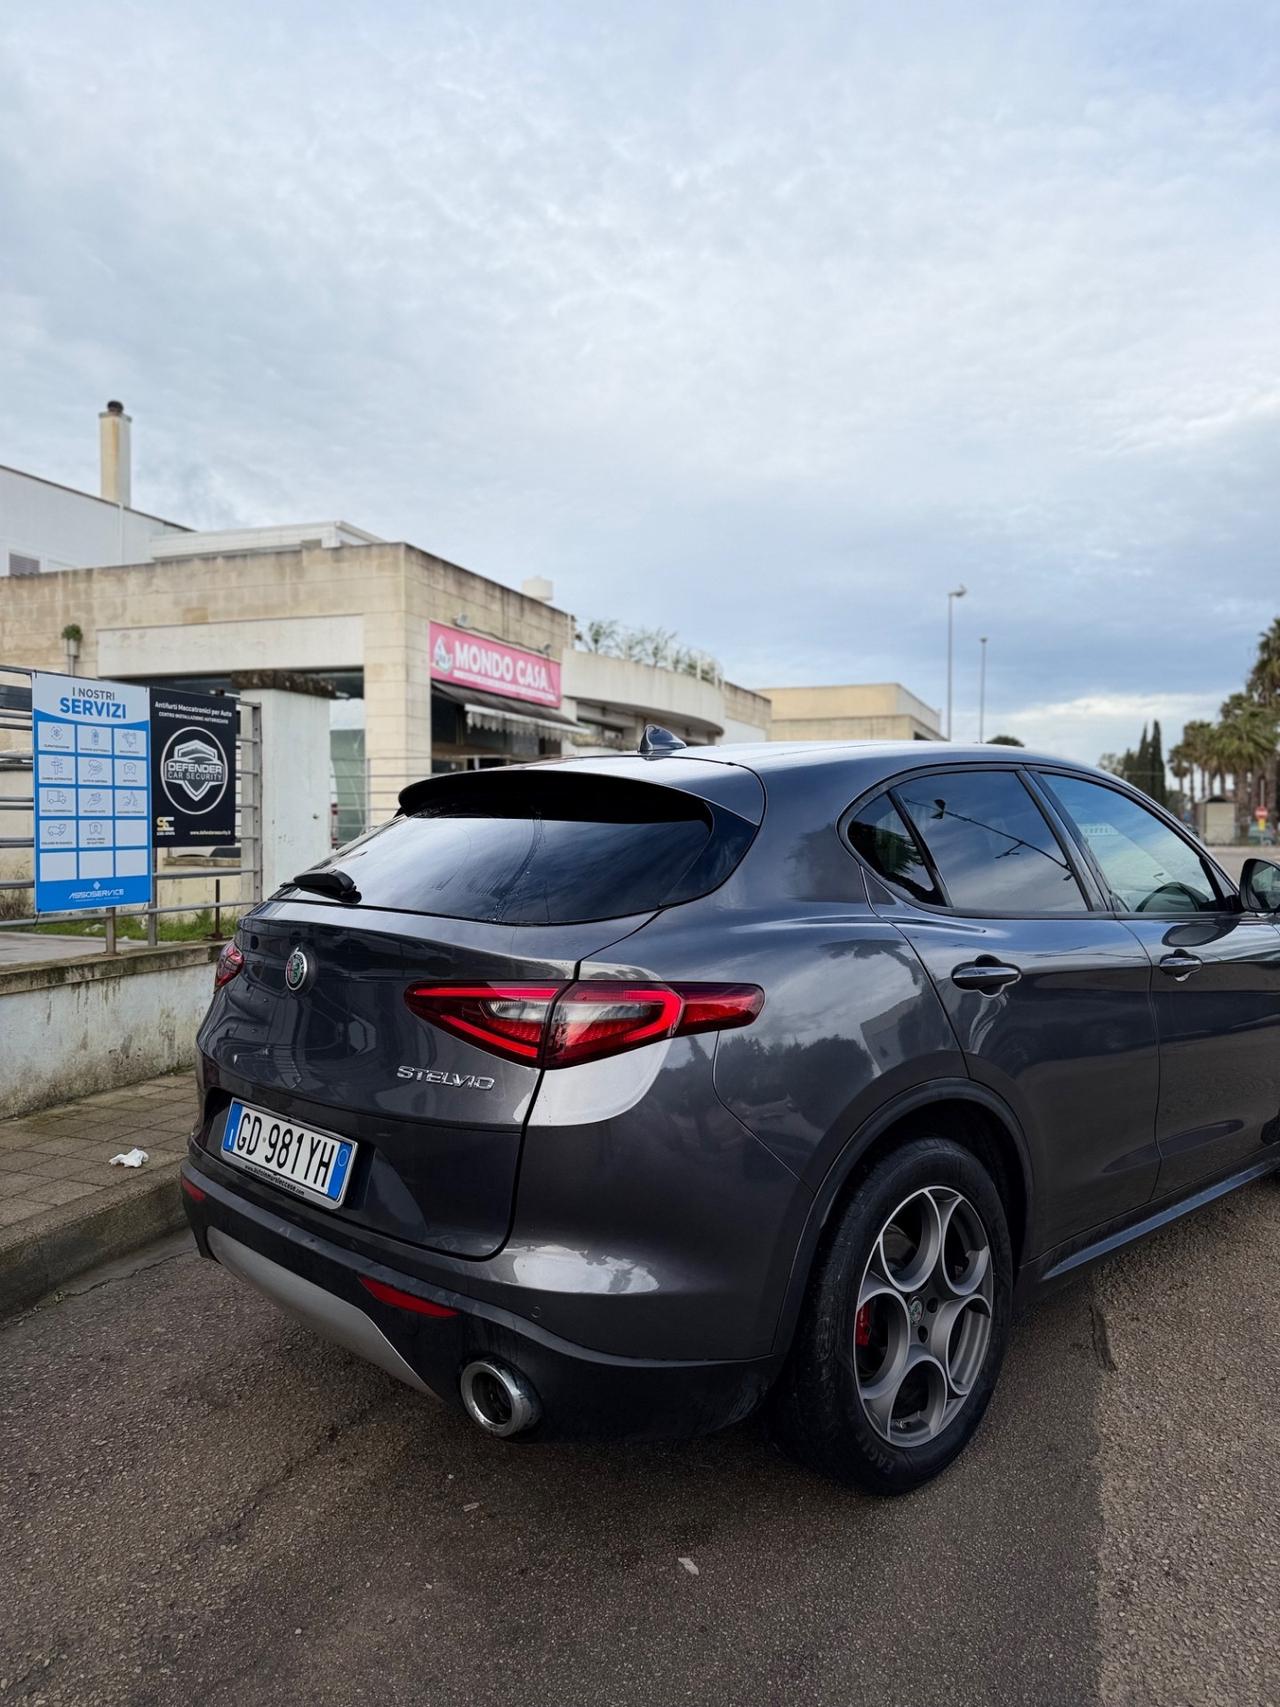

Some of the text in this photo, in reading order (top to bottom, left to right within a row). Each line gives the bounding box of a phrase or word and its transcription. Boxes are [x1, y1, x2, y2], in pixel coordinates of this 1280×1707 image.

[454, 640, 513, 682] MONDO
[516, 660, 548, 690] CASA
[72, 687, 115, 701] I NOSTRI
[60, 697, 126, 719] SERVIZI
[155, 701, 232, 718] Antifurti Meccatronici per Auto
[167, 762, 222, 774] DEFENDER
[168, 771, 223, 781] CAR SECURITY
[396, 1065, 496, 1091] STELVIO
